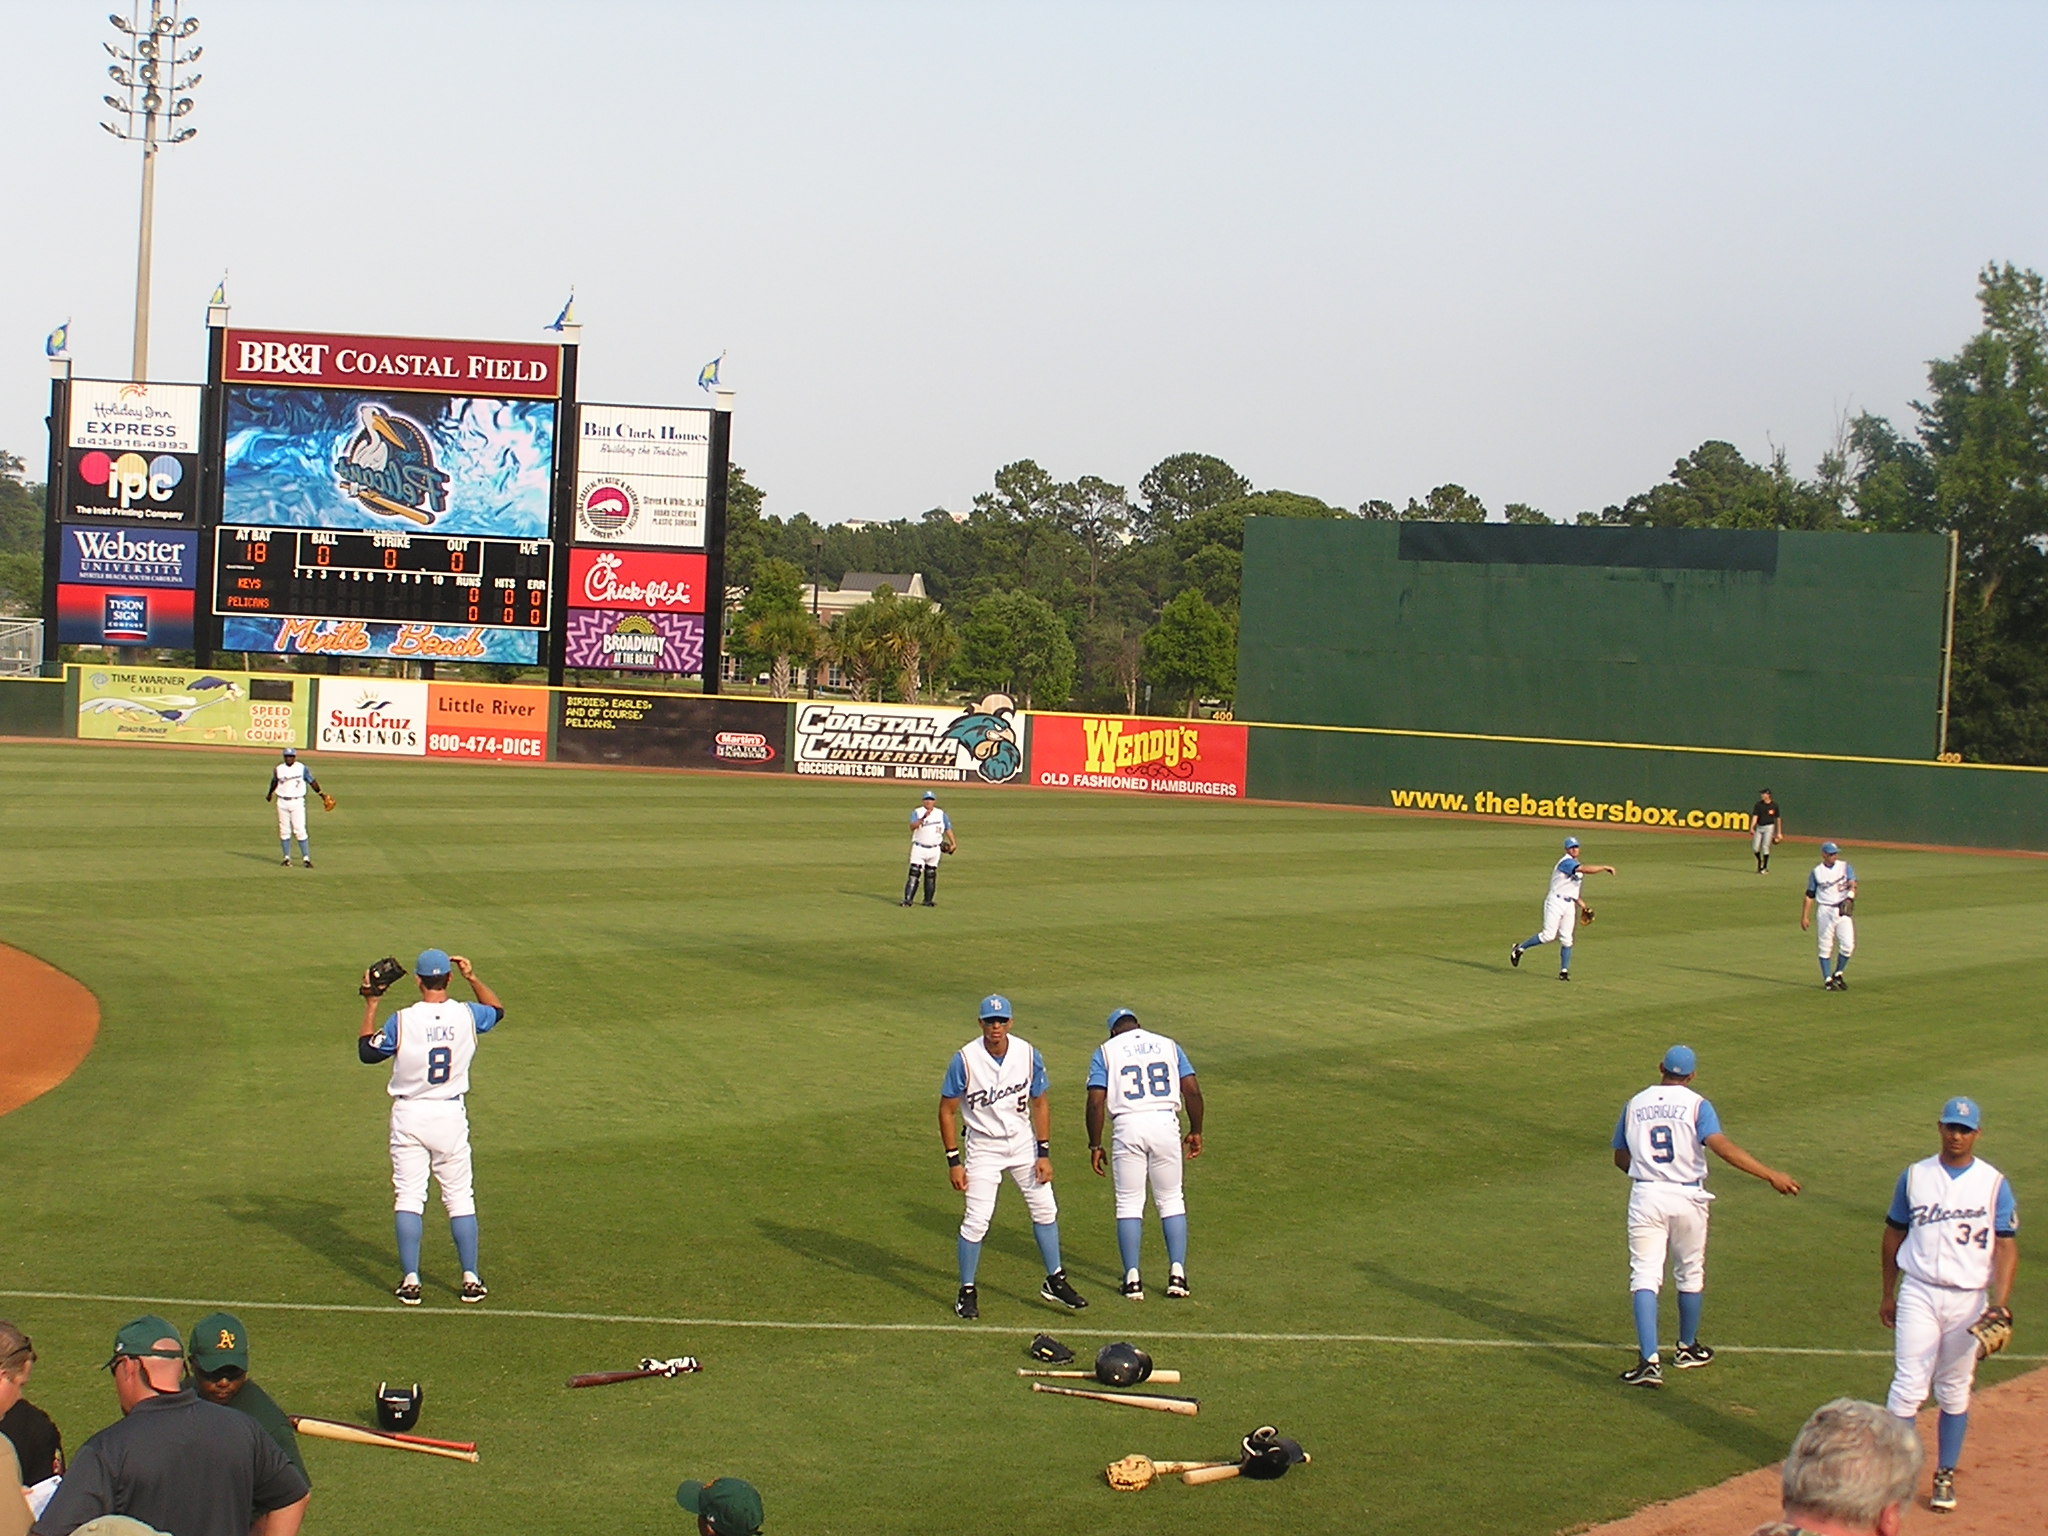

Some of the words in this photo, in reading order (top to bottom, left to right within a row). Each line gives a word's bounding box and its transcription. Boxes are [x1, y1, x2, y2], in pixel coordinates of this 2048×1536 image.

[236, 341, 329, 375] BB&T
[335, 349, 459, 378] COASTAL
[467, 355, 548, 382] FIELD
[93, 402, 142, 420] Holiday
[145, 406, 171, 419] Inn
[87, 421, 176, 437] EXPRESS
[584, 422, 611, 437] Bill
[616, 423, 655, 439] Clark
[661, 426, 708, 441] Homes
[108, 461, 174, 508] ipc
[75, 505, 91, 514] The
[112, 507, 144, 518] Printing
[145, 508, 184, 521] Company
[236, 529, 250, 541] AT
[252, 530, 272, 542] BAT
[311, 533, 339, 545] BALL
[373, 536, 411, 549] STRIKE
[73, 530, 185, 562] Webster
[246, 542, 267, 563] 18
[446, 539, 469, 551] OUT
[317, 545, 330, 565] 0
[384, 549, 397, 569] 0
[451, 552, 464, 572] 0
[80, 561, 182, 575] UNIVERSITY
[237, 577, 262, 589] KEYS
[293, 569, 299, 579] 1
[306, 569, 314, 579] 2
[320, 569, 328, 580] 3
[338, 571, 346, 581] 4
[352, 572, 361, 582] 5
[366, 572, 375, 582] 6
[387, 573, 394, 583] 7
[400, 573, 408, 584] 8
[414, 575, 422, 585] 9
[432, 575, 444, 586] 10
[455, 576, 481, 587] RUNS
[494, 578, 516, 589] HITS
[527, 580, 546, 590] ERR
[109, 600, 144, 611] TYSON
[227, 595, 270, 609] PELICANS
[469, 587, 479, 603] 0
[504, 589, 514, 605] 0
[531, 590, 541, 606] 0
[113, 610, 139, 621] SIGN
[468, 606, 478, 621] 0
[503, 608, 514, 623] 0
[530, 609, 540, 625] 0
[603, 633, 666, 656] BROADWAY
[111, 673, 137, 684] TIME
[138, 674, 186, 686] WARNER
[130, 685, 164, 694] CABLE
[251, 705, 291, 717] SPEED
[438, 696, 485, 714] Little
[492, 699, 536, 717] River
[566, 707, 586, 717] AND
[587, 708, 601, 718] OF
[254, 717, 289, 729] DOES
[330, 709, 411, 730] SunCruz
[565, 718, 616, 729] PELICANS.
[798, 704, 940, 735] COASTAL
[1212, 710, 1234, 722] 400
[246, 729, 295, 742] COUNT!
[429, 733, 541, 757] 800-474-DICE
[801, 732, 960, 760] CAROLINA
[1082, 718, 1198, 775] Wendy's
[829, 749, 956, 765] UNIVERSITY
[797, 762, 885, 778] GOCCUSPORTS.COM
[895, 766, 919, 779] NCAA
[921, 767, 960, 781] DIVISION
[1041, 772, 1070, 786] OLD
[1073, 774, 1149, 791] FASHIONED
[1151, 779, 1237, 797] HAMBURGERS
[1391, 789, 1469, 812] www.
[1474, 790, 1750, 831] thebattersbox.com
[425, 1026, 455, 1043] HICKS
[427, 1046, 452, 1085] 8
[1120, 1061, 1172, 1101] 38
[1016, 1094, 1027, 1113] 5
[1636, 1104, 1688, 1124] RODRIGUEZ
[1650, 1125, 1675, 1164] 9
[1955, 1223, 1989, 1250] 34
